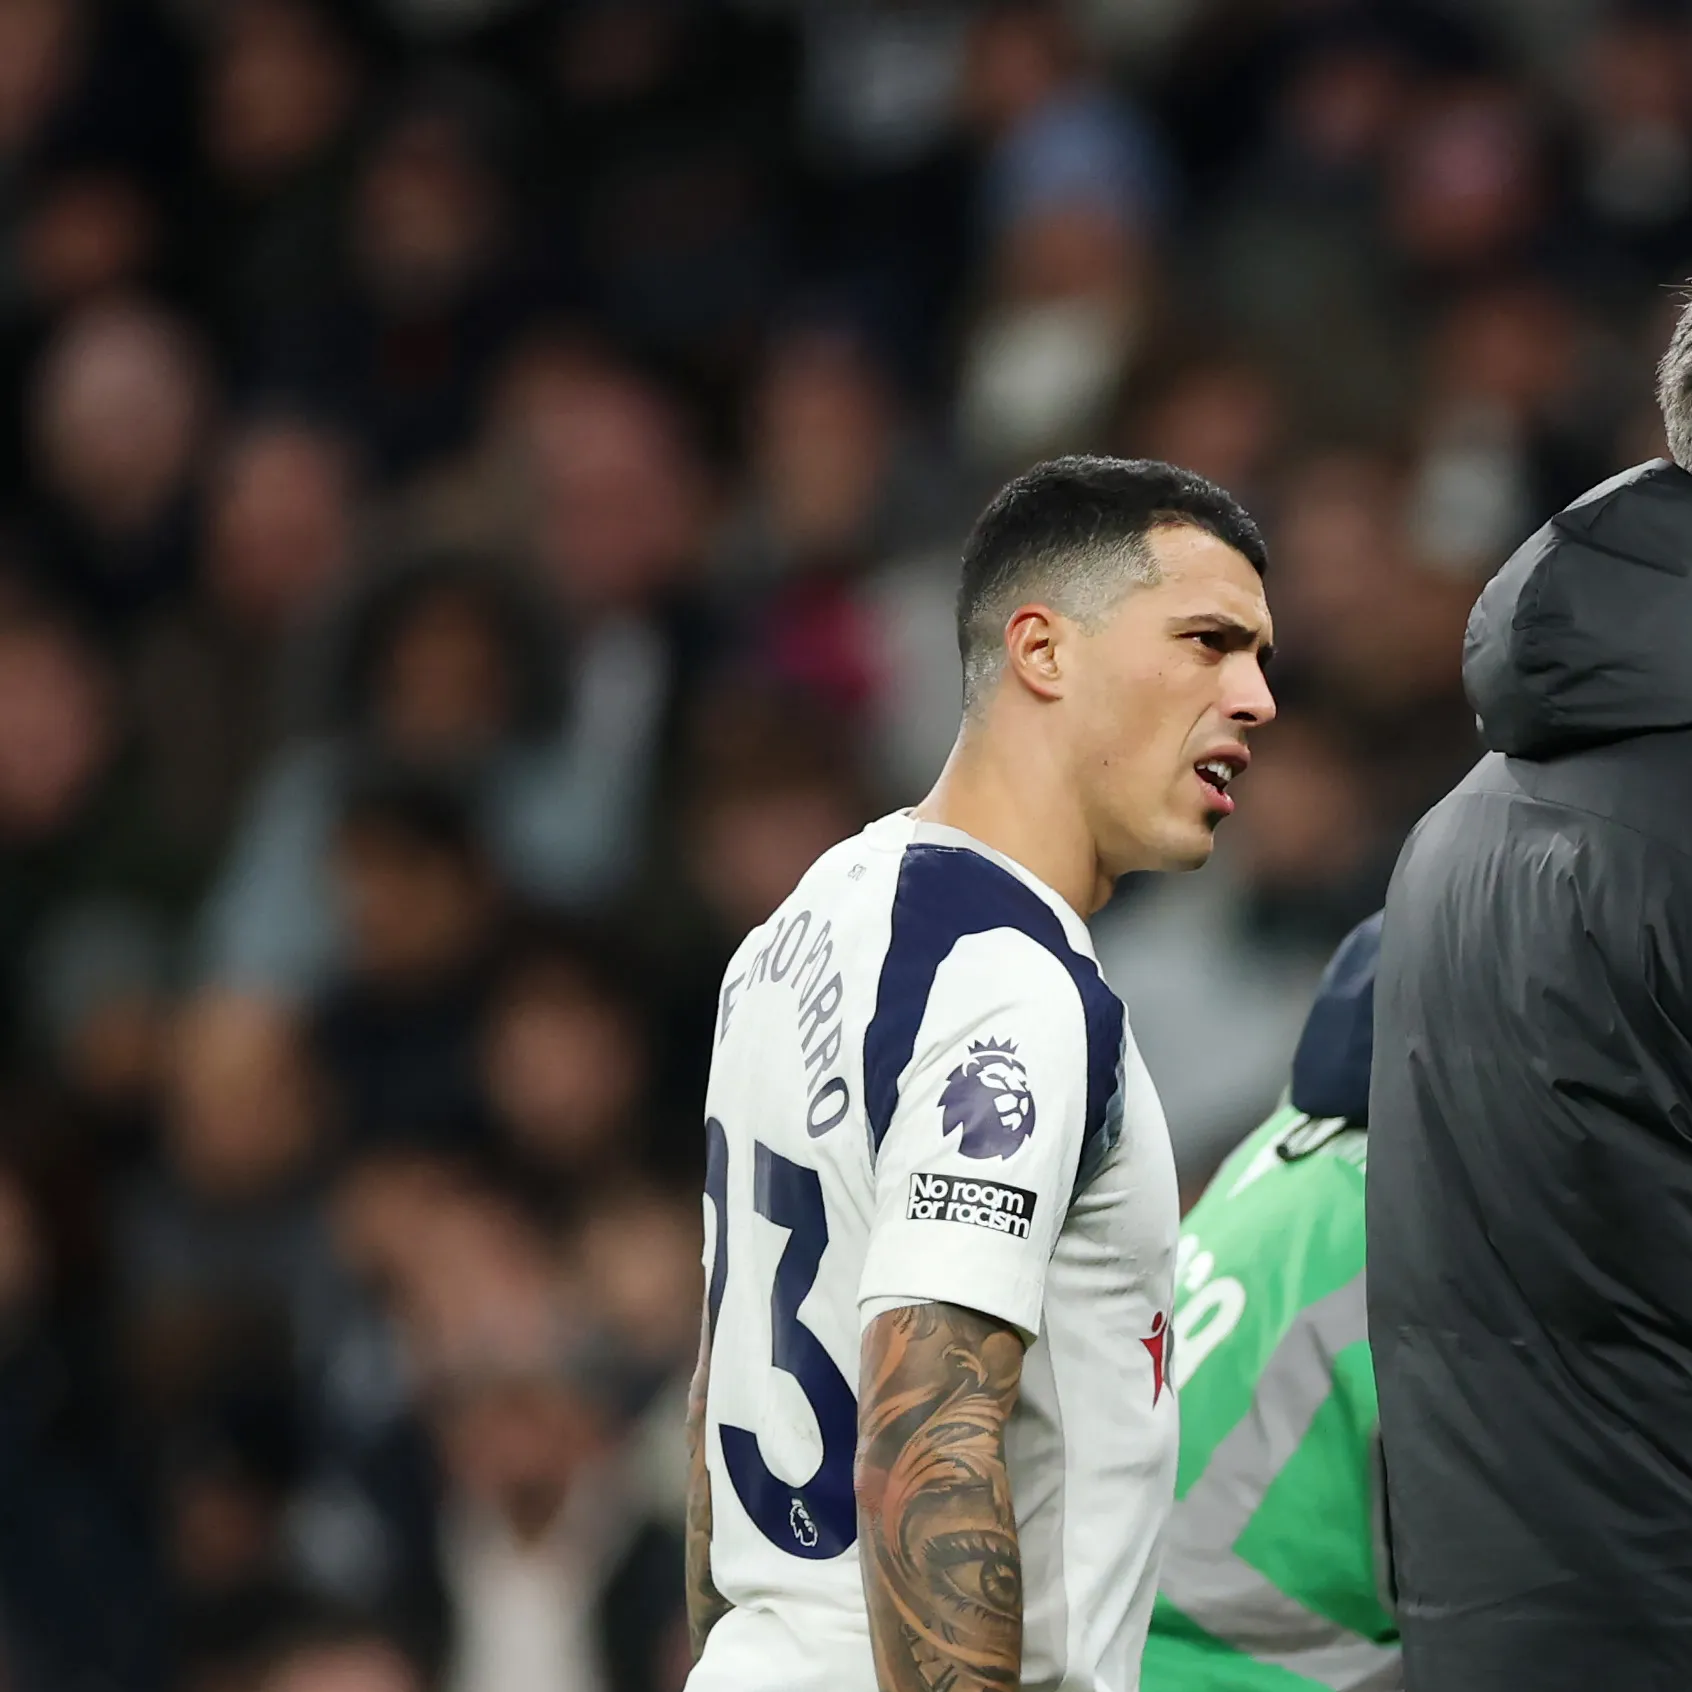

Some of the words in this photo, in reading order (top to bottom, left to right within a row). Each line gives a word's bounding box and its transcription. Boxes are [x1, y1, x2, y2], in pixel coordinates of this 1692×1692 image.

[910, 1173, 948, 1199] No
[951, 1181, 1025, 1214] room
[907, 1196, 945, 1219] for
[945, 1201, 1030, 1239] racism
